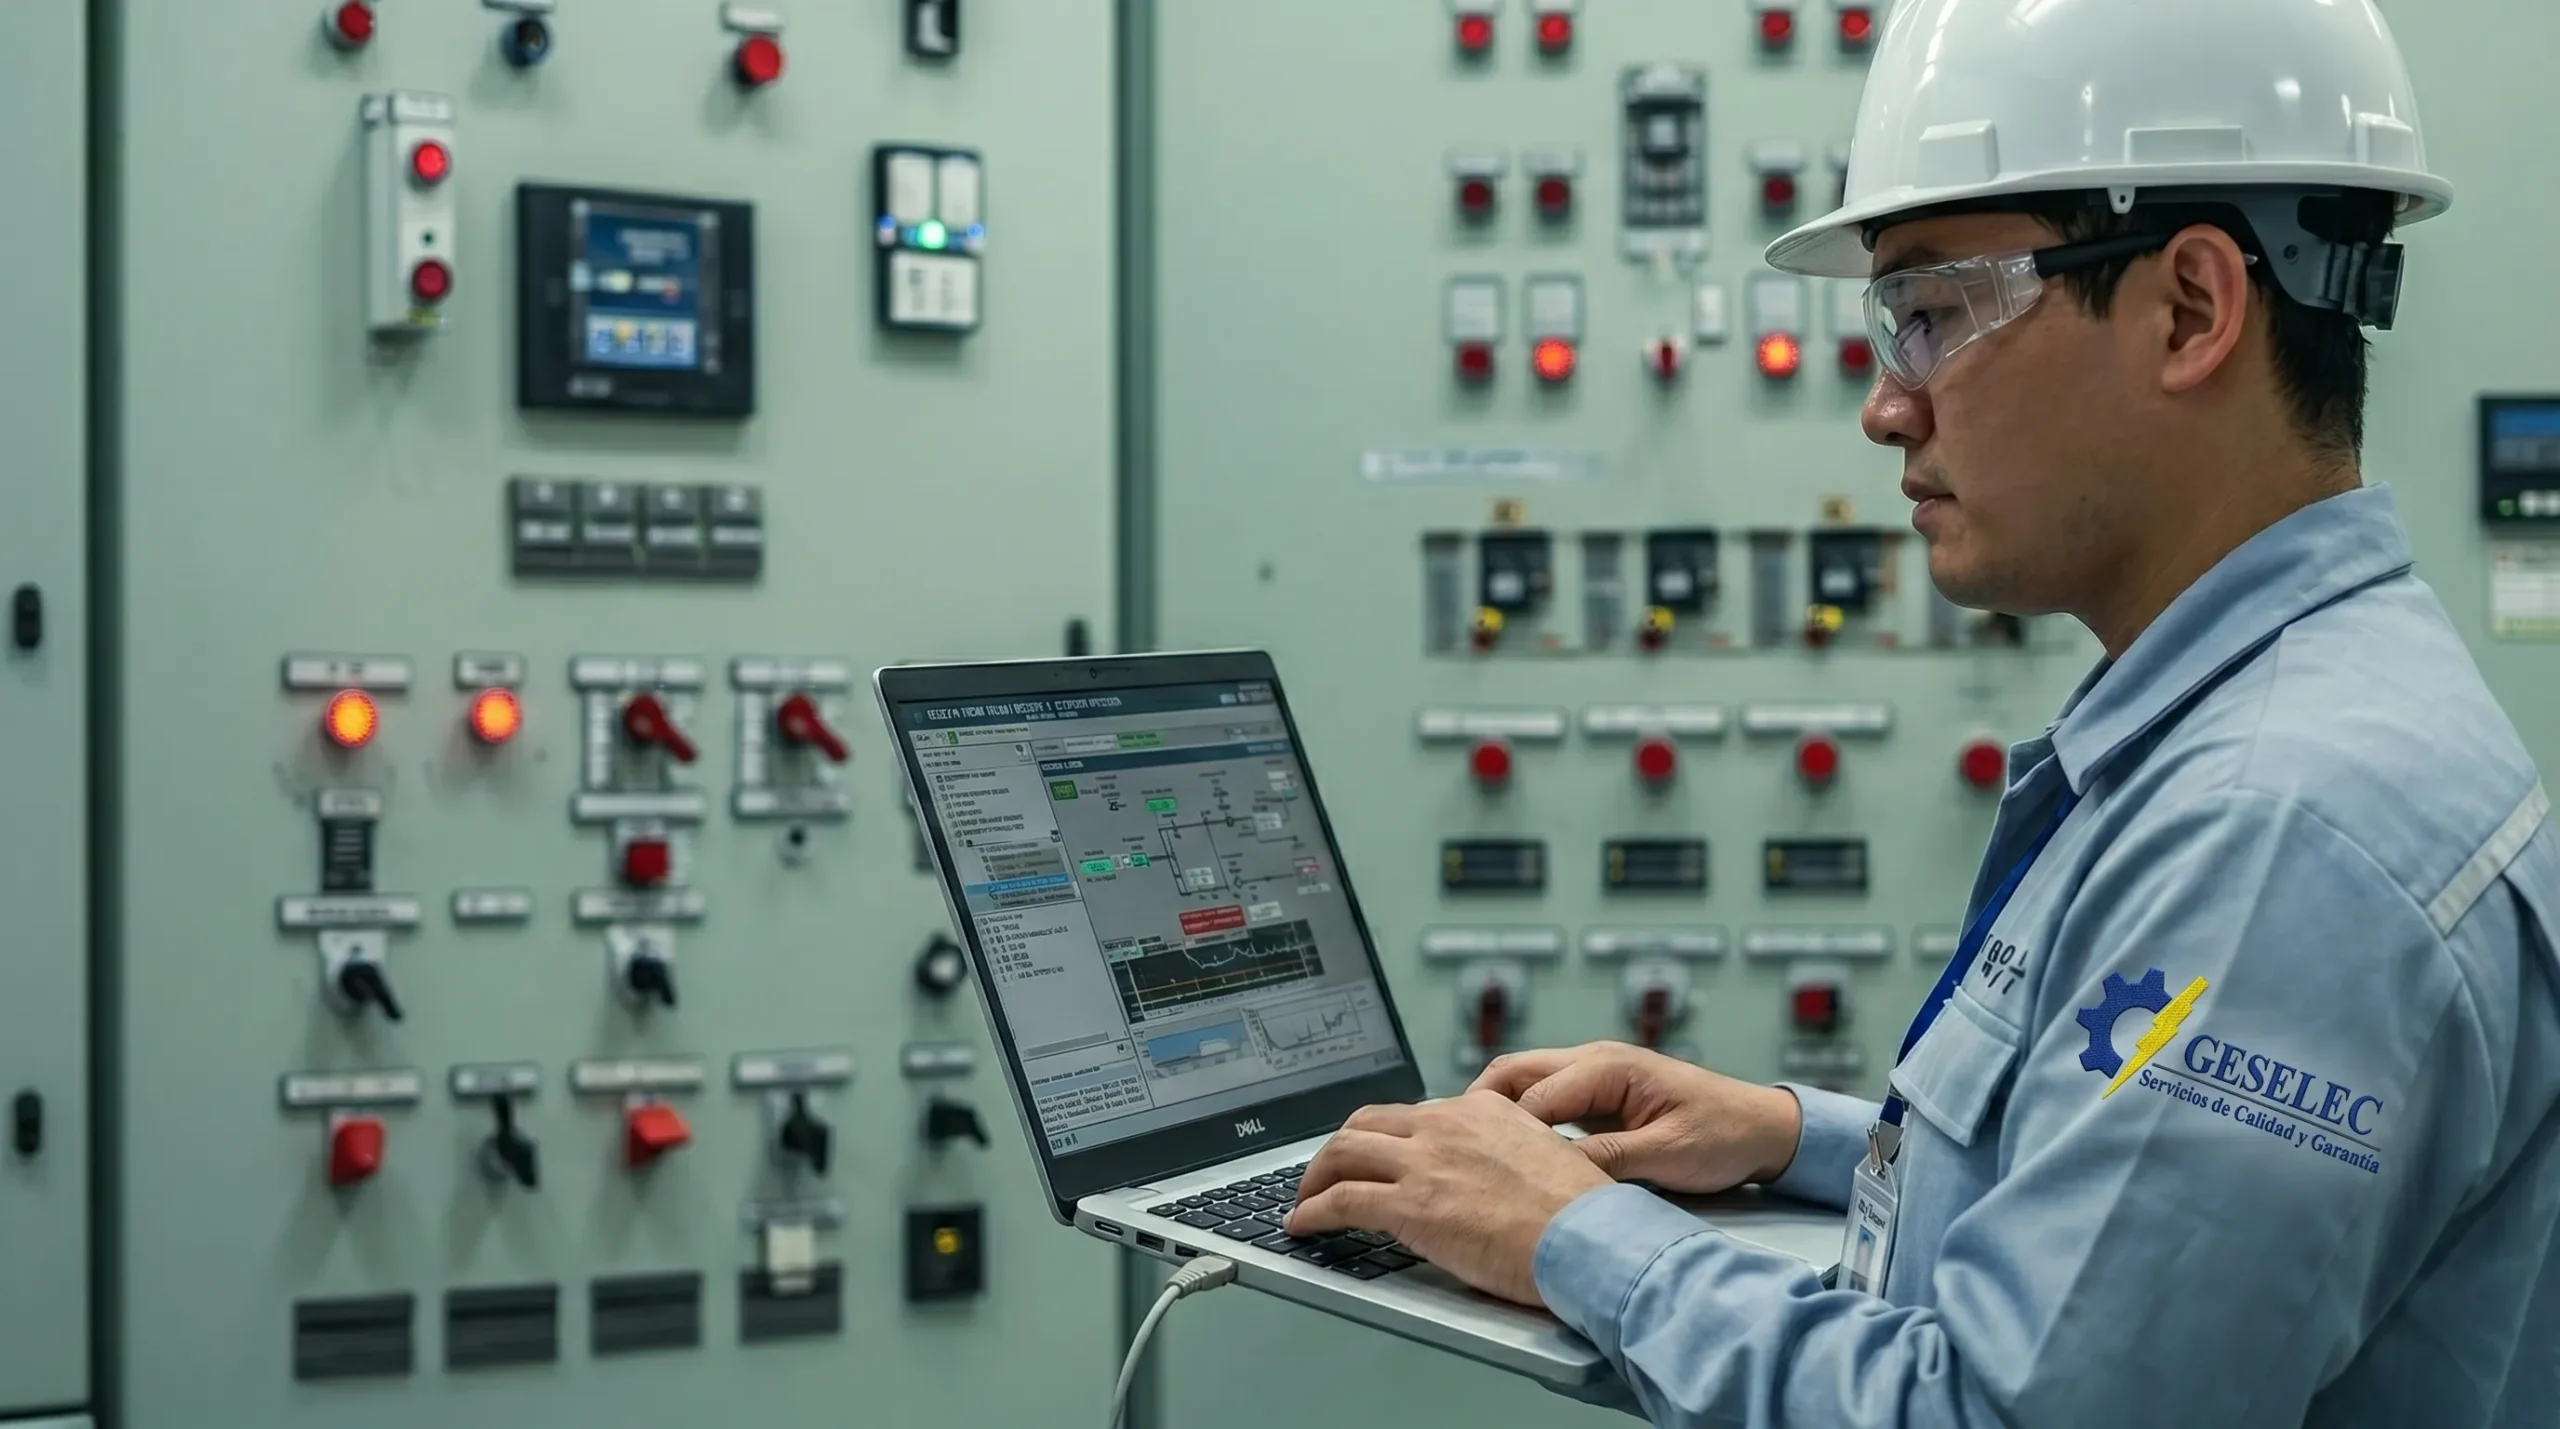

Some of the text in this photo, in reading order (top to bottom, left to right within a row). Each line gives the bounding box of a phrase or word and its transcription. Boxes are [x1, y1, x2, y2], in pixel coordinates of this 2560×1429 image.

[2138, 1069, 2381, 1174] Servicios de Calidad y Garantía
[2184, 1034, 2383, 1136] GESELEC
